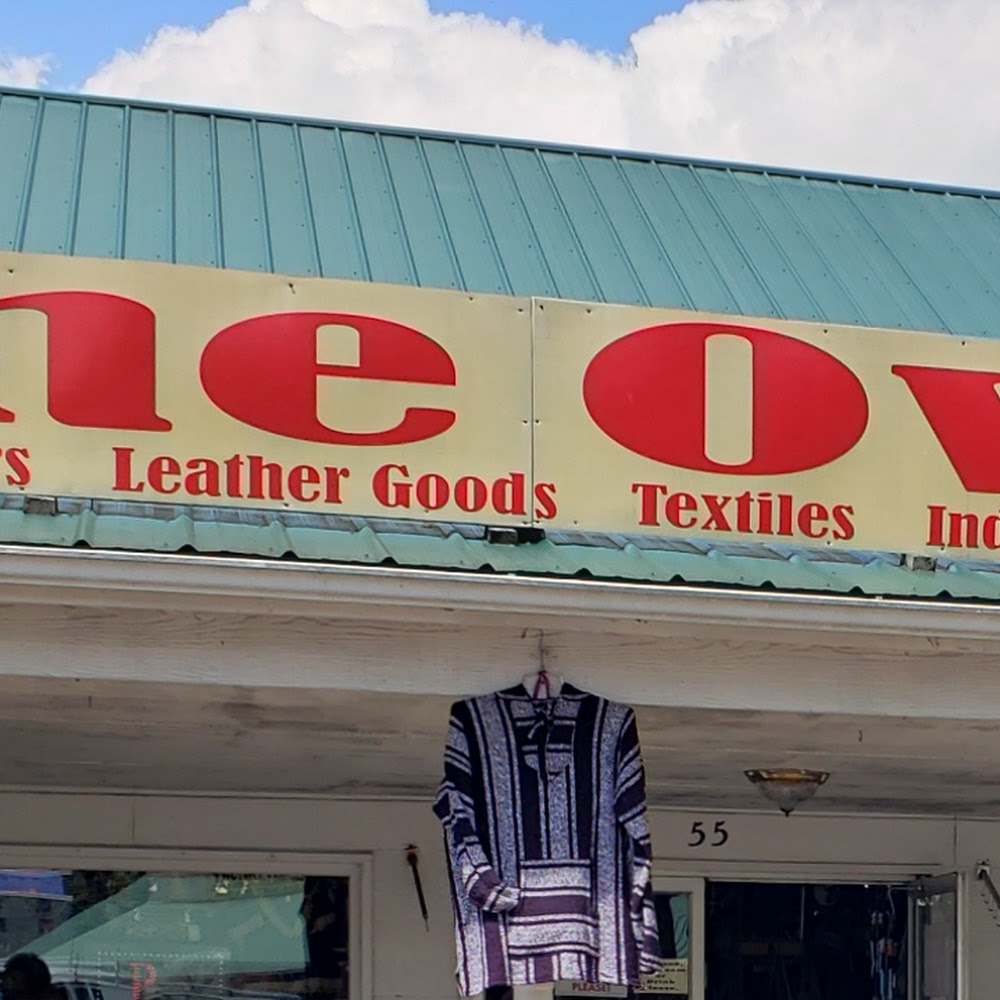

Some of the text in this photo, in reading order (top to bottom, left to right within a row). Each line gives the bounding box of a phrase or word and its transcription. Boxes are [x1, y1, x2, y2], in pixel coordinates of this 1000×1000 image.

[112, 446, 351, 505] Leather
[371, 463, 559, 520] Goods
[629, 481, 856, 540] Textiles
[687, 820, 729, 847] 55
